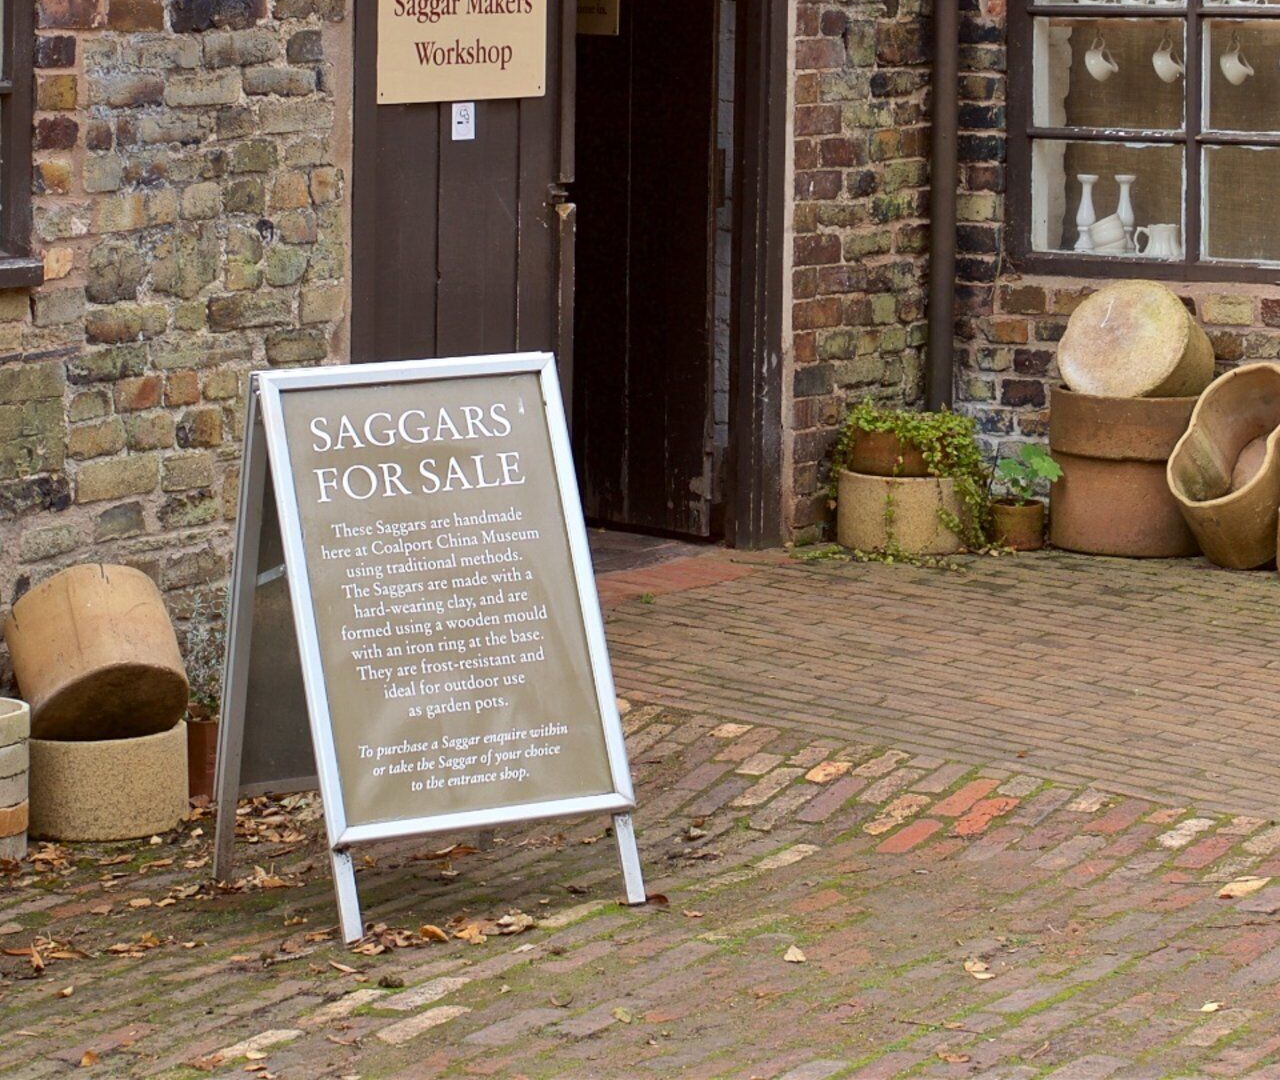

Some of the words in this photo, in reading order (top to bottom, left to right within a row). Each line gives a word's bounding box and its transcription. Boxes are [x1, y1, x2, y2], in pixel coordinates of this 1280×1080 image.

[414, 38, 513, 71] Workshop
[310, 403, 511, 452] SAGGARS
[312, 462, 412, 502] FOR
[419, 451, 525, 493] SALE
[330, 522, 373, 537] These
[375, 519, 427, 535] Saggars
[430, 518, 450, 528] are
[453, 506, 522, 526] handmade
[320, 545, 351, 559] here
[354, 545, 368, 556] at
[371, 537, 433, 555] Coalport
[436, 532, 478, 548] China
[480, 529, 539, 544] Museum
[346, 562, 383, 578] using
[386, 552, 456, 574] traditional
[460, 547, 522, 567] methods.
[341, 583, 370, 598] The
[372, 581, 423, 597] Saggars
[427, 579, 448, 590] are
[451, 570, 488, 588] made
[490, 566, 522, 582] with
[525, 570, 533, 580] a
[353, 597, 444, 618] hard-wearing
[447, 593, 476, 610] clay,
[479, 588, 504, 605] and
[507, 591, 528, 602] are
[341, 621, 392, 640] formed
[395, 619, 432, 635] using
[435, 621, 443, 631] a
[445, 611, 500, 628] wooden
[503, 604, 547, 623] mould
[351, 643, 382, 659] with
[386, 646, 402, 656] an
[405, 640, 434, 655] iron
[437, 636, 466, 651] ring
[468, 637, 481, 648] at
[484, 630, 507, 646] the
[509, 628, 544, 643] base.
[356, 664, 392, 680] They
[397, 664, 417, 676] are
[420, 653, 516, 673] frost-resistant
[519, 645, 544, 662] and
[383, 680, 416, 698] ideal
[419, 679, 440, 694] for
[444, 674, 499, 691] outdoor
[502, 674, 525, 685] use
[408, 706, 422, 716] as
[426, 696, 471, 717] garden
[474, 696, 508, 712] pots.
[358, 744, 373, 758] To
[376, 739, 428, 759] purchase
[430, 740, 438, 749] a
[441, 735, 480, 750] Saggar
[483, 727, 527, 744] enquire
[528, 722, 568, 737] within
[372, 766, 386, 776] or
[388, 759, 414, 774] take
[416, 757, 435, 771] the
[438, 755, 478, 770] Saggar
[479, 748, 493, 766] of
[494, 749, 522, 764] your
[524, 743, 560, 758] choice
[411, 780, 423, 791] to
[426, 775, 444, 789] the
[447, 772, 497, 786] entrance
[499, 766, 529, 780] shop.
